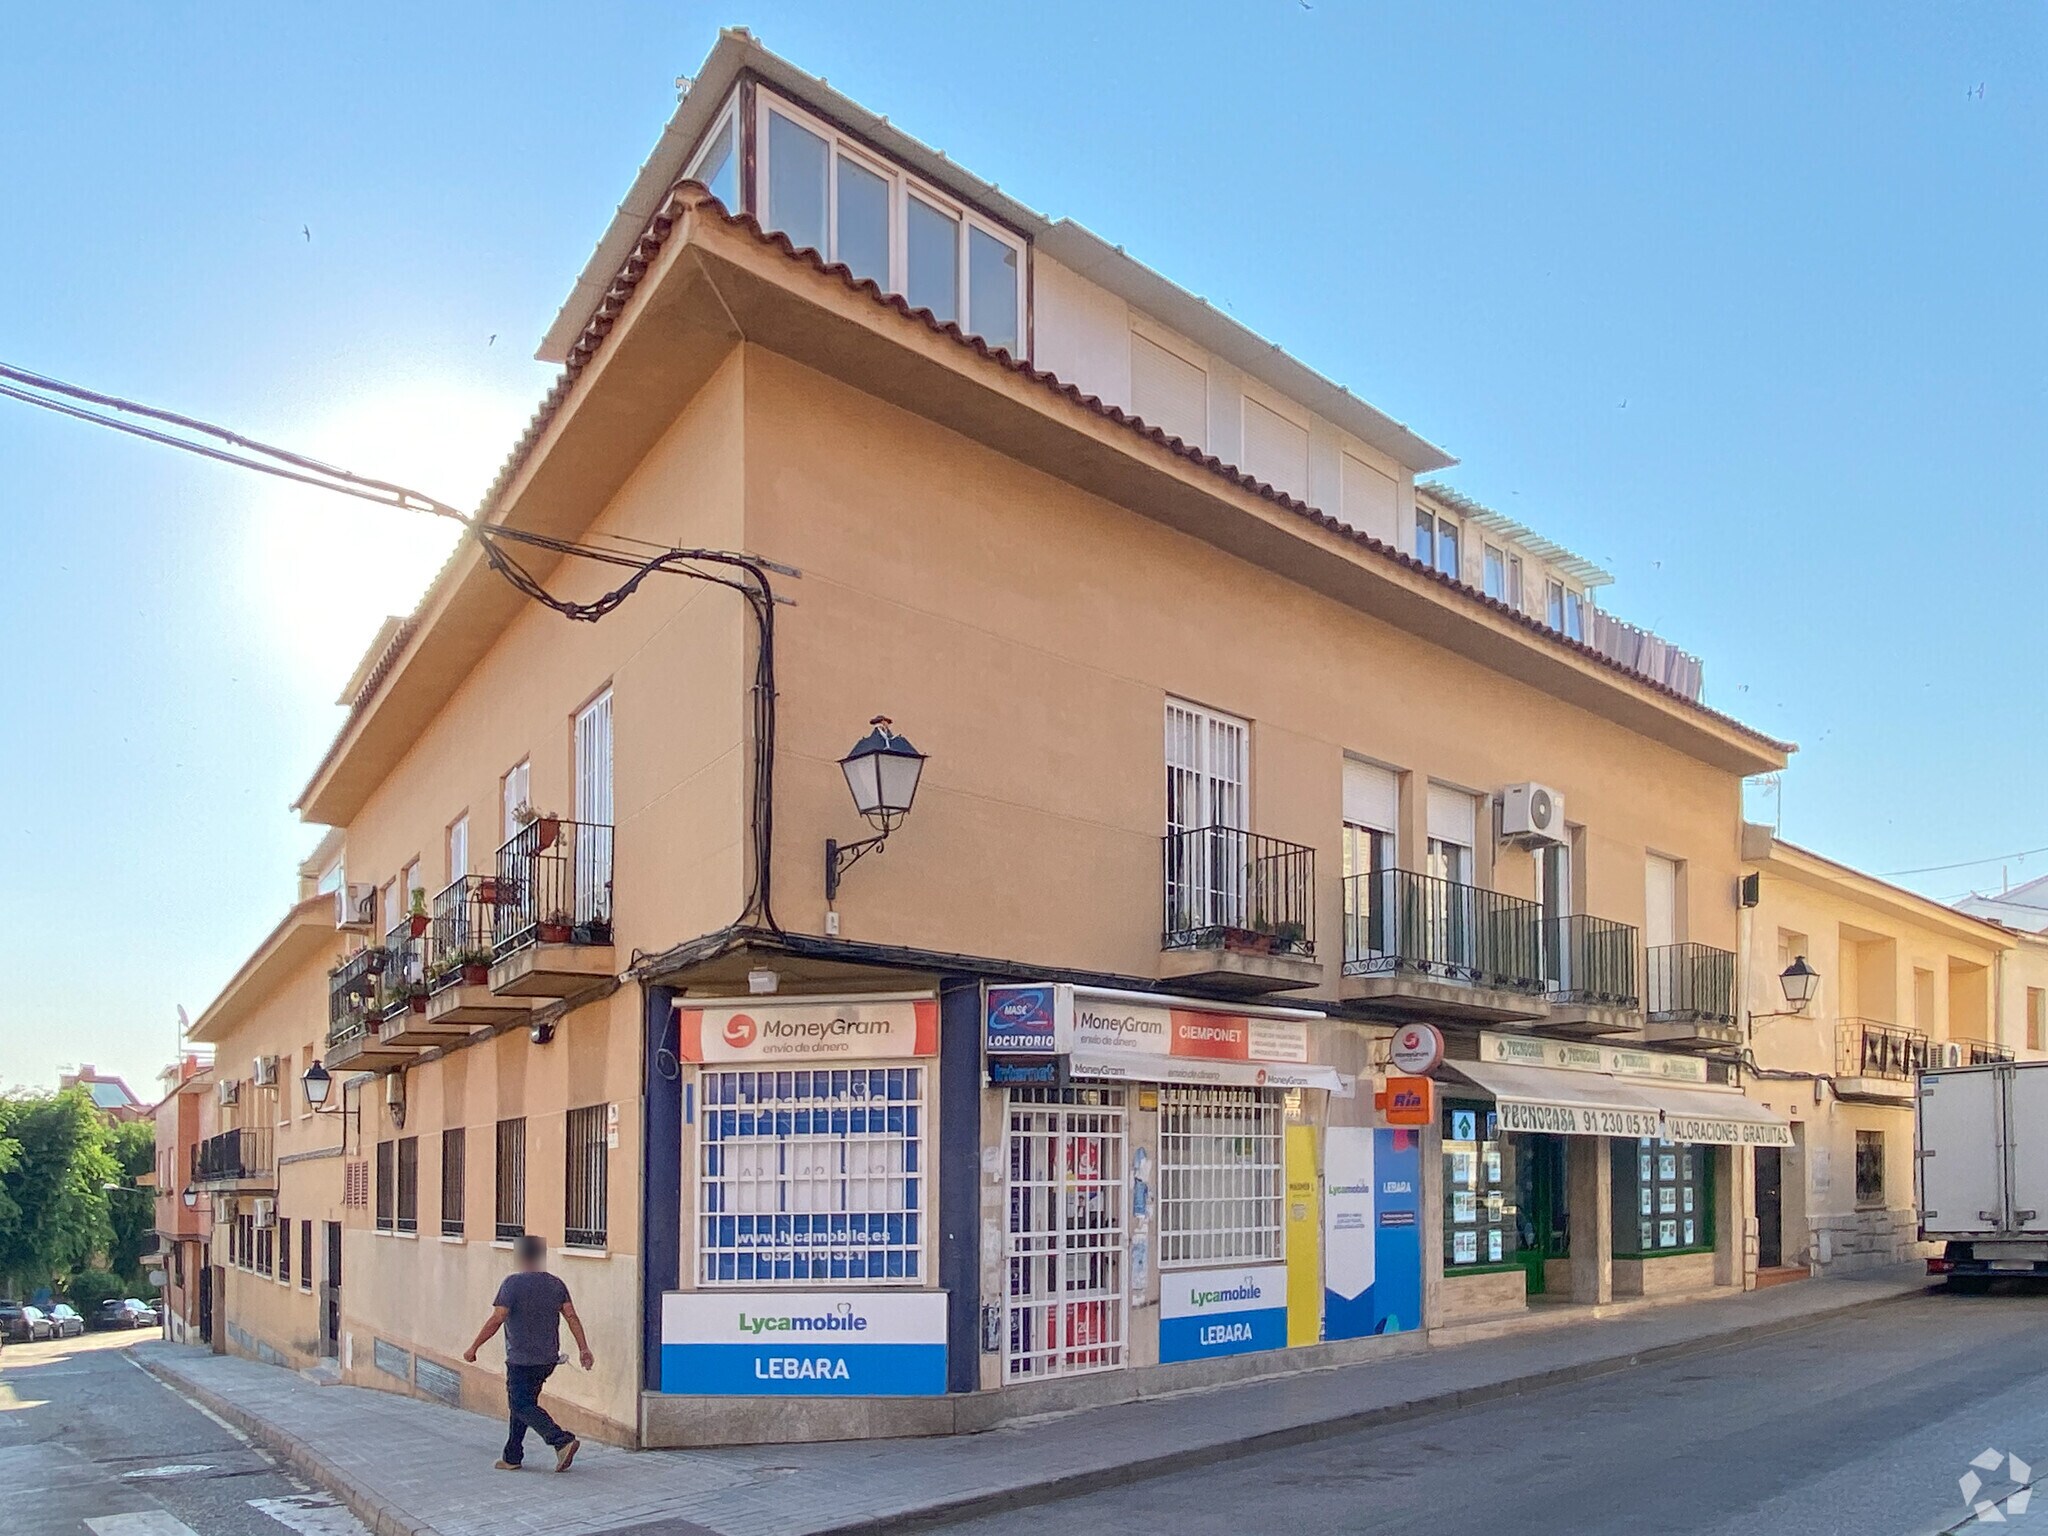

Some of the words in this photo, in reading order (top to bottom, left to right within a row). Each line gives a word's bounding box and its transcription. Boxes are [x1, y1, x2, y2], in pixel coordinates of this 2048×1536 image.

[763, 1018, 889, 1040] MoneyGram
[1080, 1013, 1162, 1036] MoneyGram
[988, 1035, 1054, 1047] LOCUTORIO
[1179, 1025, 1242, 1043] CIEMPONET
[795, 1042, 810, 1053] de
[811, 1042, 849, 1052] dinero
[1074, 1063, 1126, 1076] MoneyGram
[1267, 1075, 1308, 1086] MoneyGram
[1394, 1090, 1421, 1107] Ria
[1501, 1104, 1576, 1132] TECNOCASA
[1583, 1110, 1598, 1131] 91
[1601, 1112, 1623, 1134] 230
[1626, 1114, 1640, 1134] 05
[1643, 1115, 1655, 1136] 33
[1668, 1120, 1738, 1142] VALORACIONES
[1743, 1125, 1788, 1144] GRATUITAS
[1329, 1184, 1369, 1196] Lycamobile
[1383, 1181, 1412, 1193] LEBARA
[737, 1229, 890, 1245] www.lycamobile.es
[1191, 1284, 1261, 1306] Lycamobile
[739, 1312, 867, 1334] Lycamobile
[1200, 1323, 1252, 1345] LEBARA
[755, 1358, 850, 1379] LEBARA
